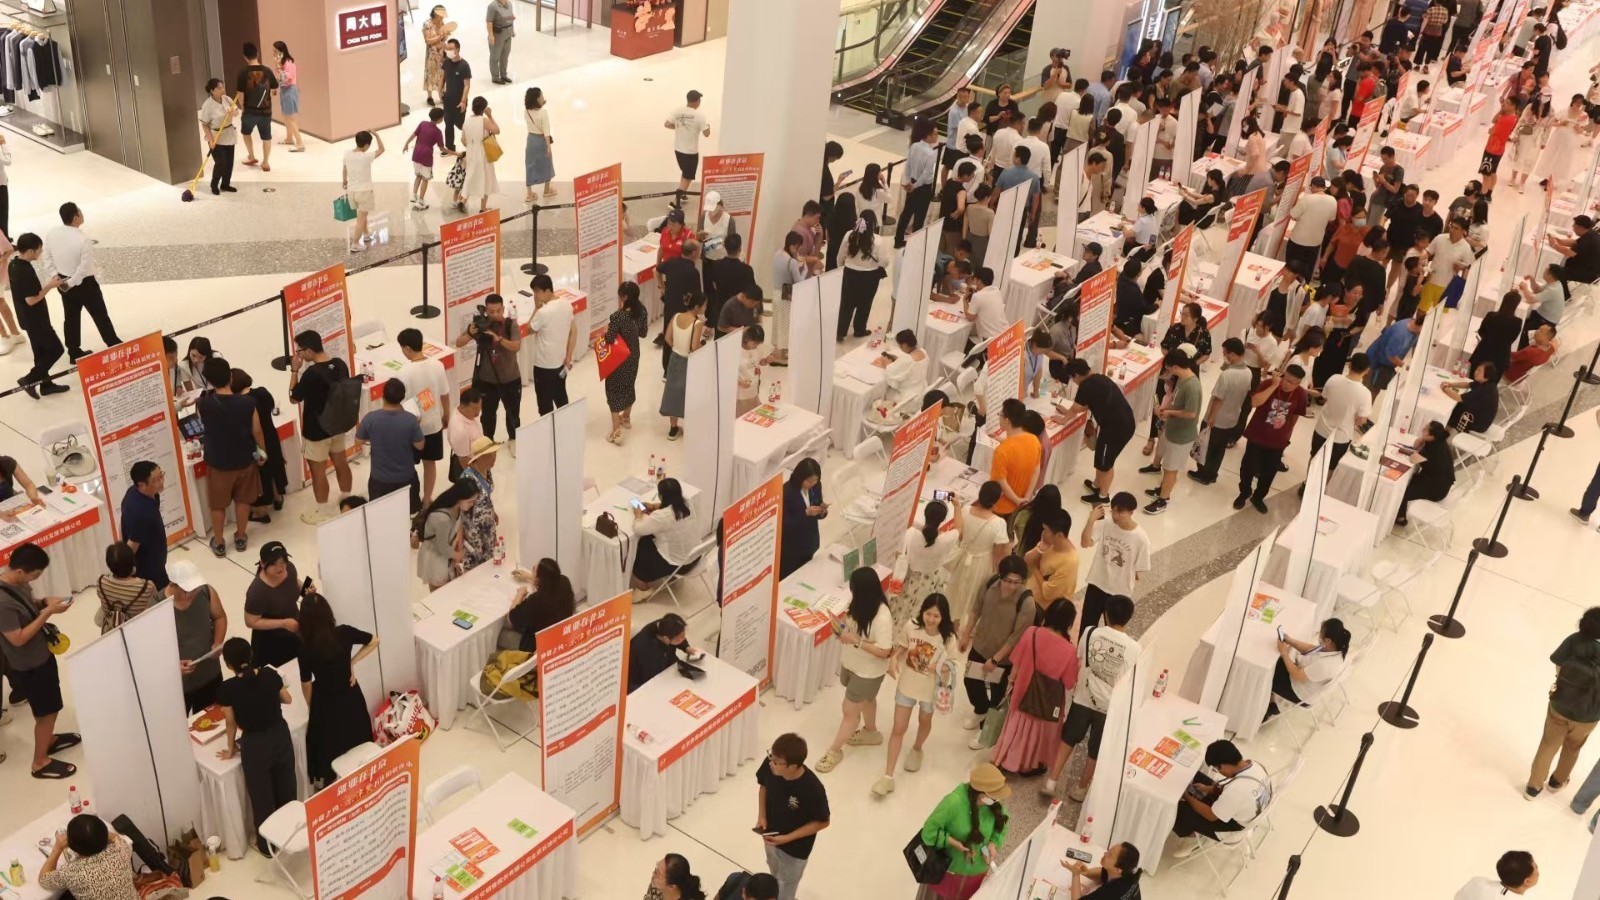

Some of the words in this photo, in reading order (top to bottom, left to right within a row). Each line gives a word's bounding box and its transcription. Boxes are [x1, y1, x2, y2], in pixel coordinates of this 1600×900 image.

[336, 758, 388, 796] 就业在北京
